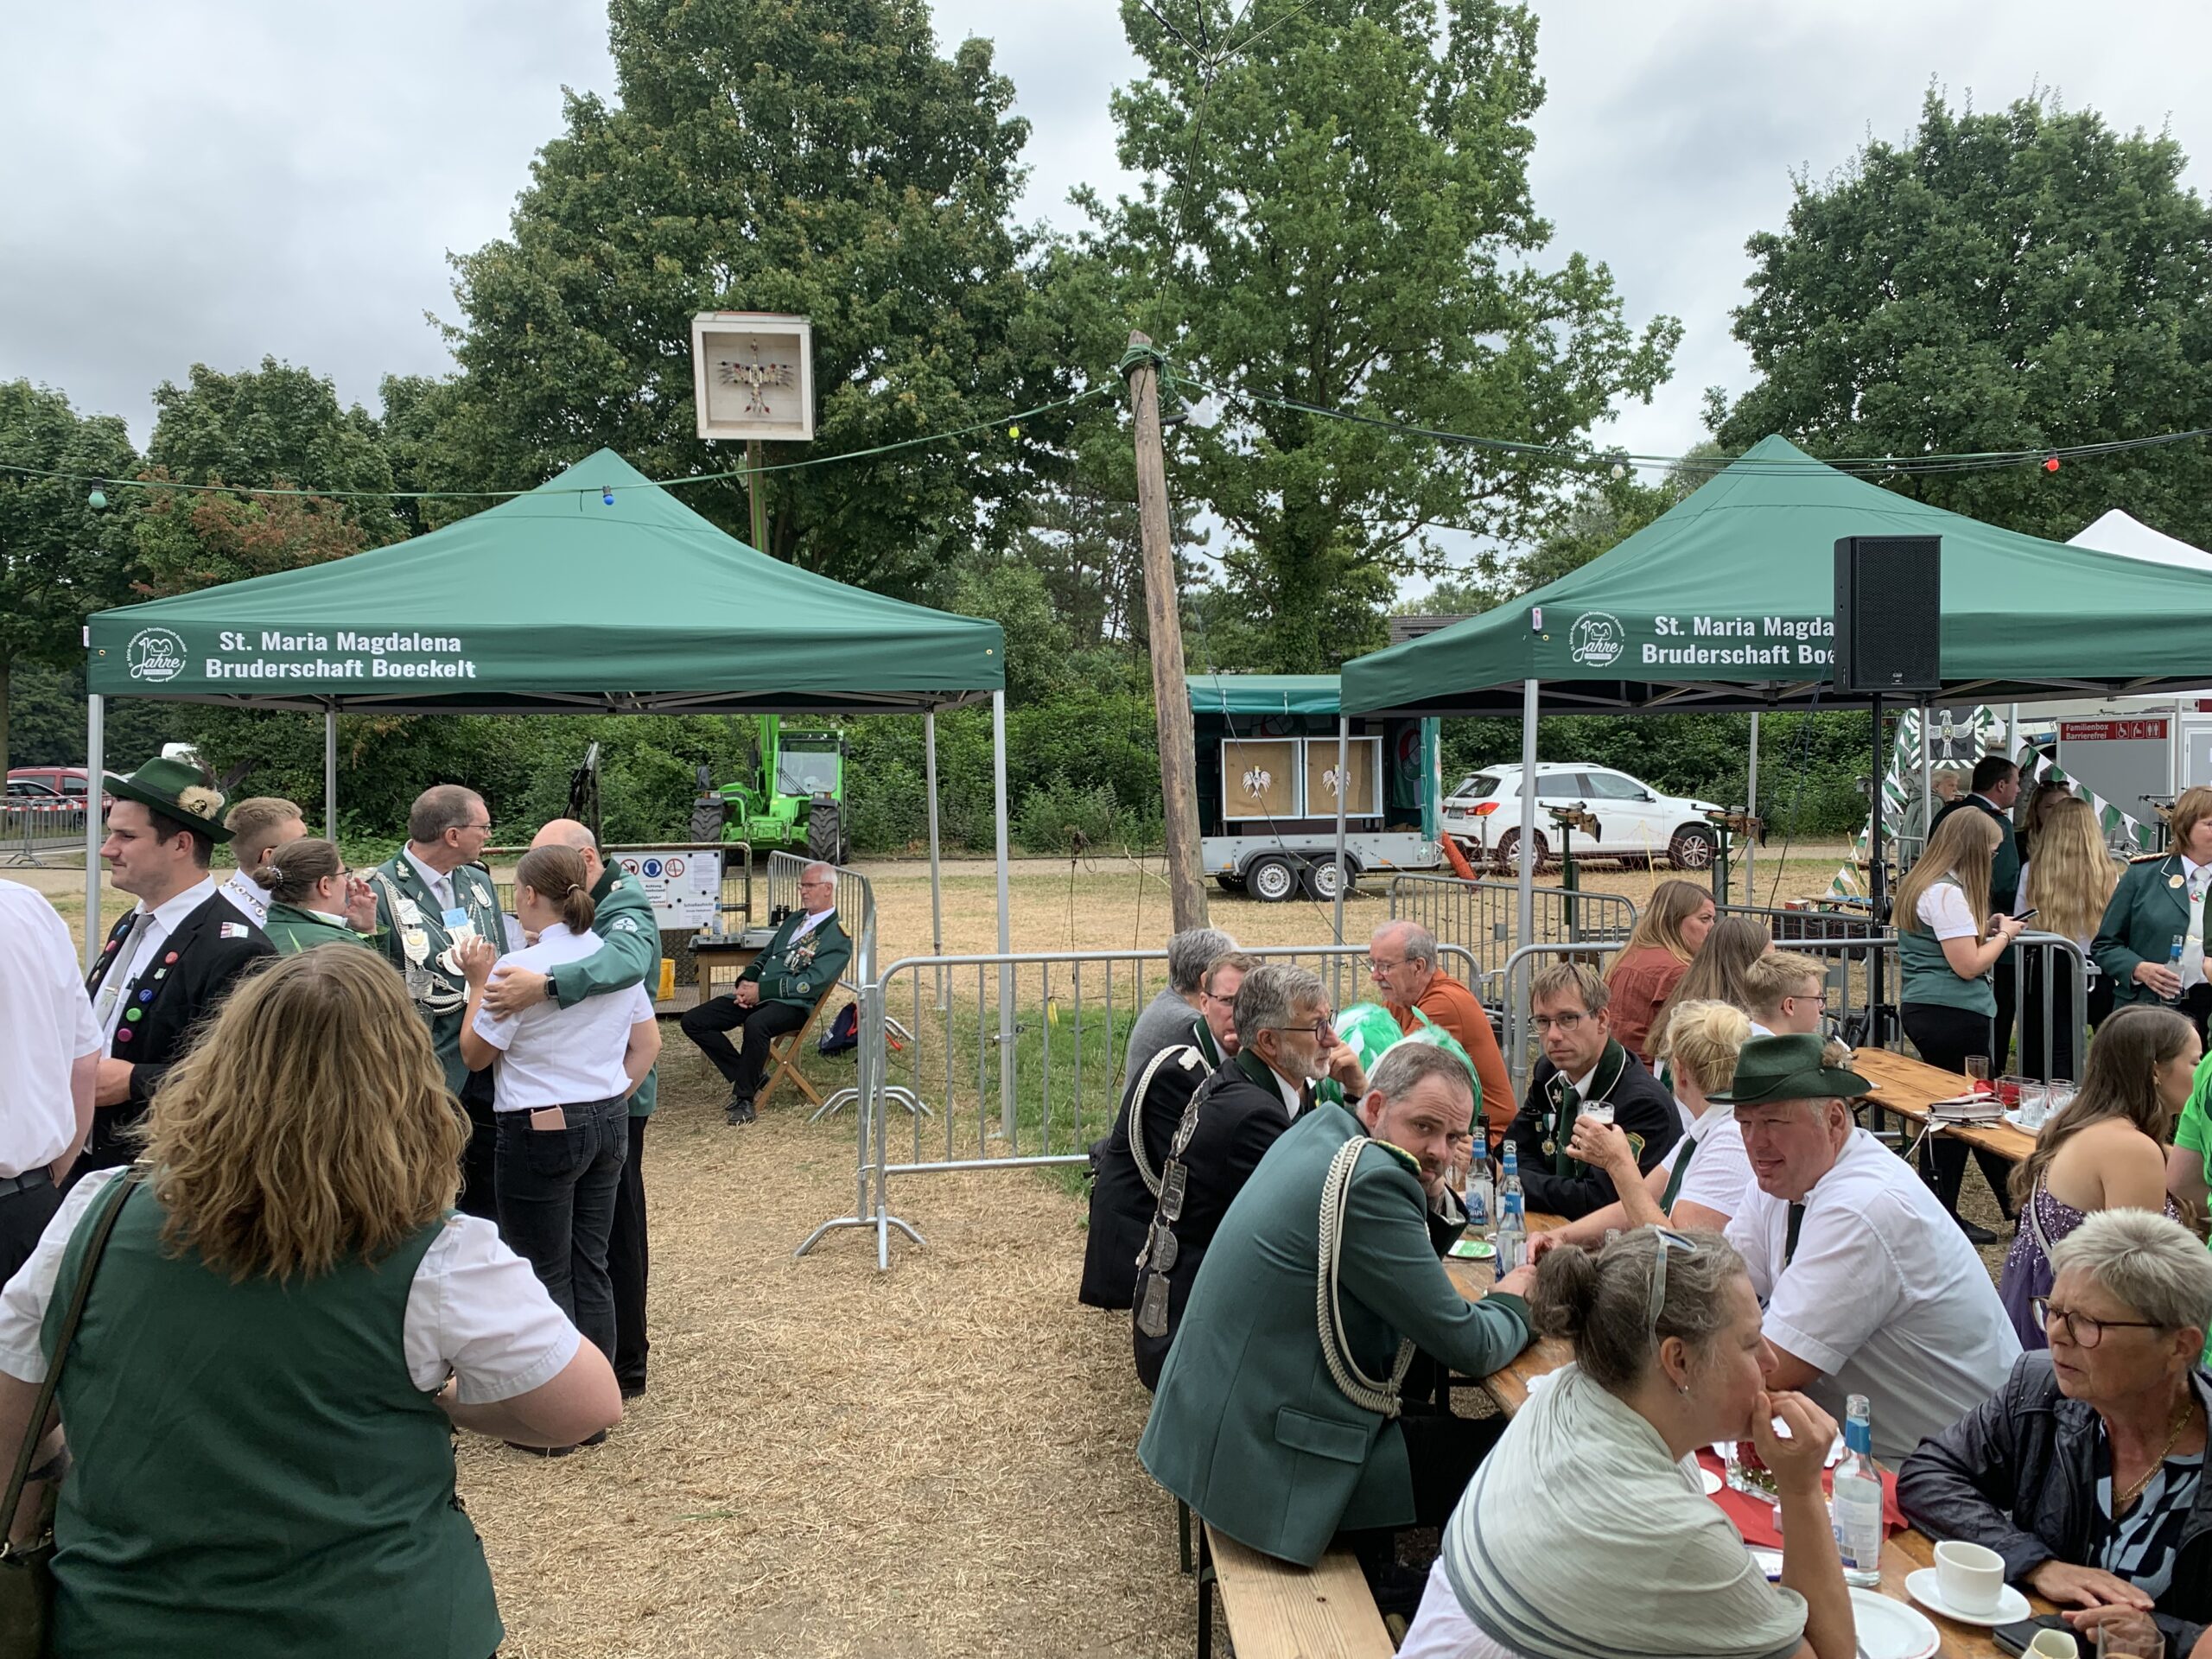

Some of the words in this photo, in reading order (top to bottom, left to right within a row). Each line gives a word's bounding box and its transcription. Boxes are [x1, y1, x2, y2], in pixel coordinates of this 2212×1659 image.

[1655, 615, 1685, 636] St.
[1693, 616, 1755, 637] Maria
[1764, 616, 1834, 640] Magda
[219, 631, 252, 652] St.
[261, 631, 328, 652] Maria
[337, 632, 461, 655] Magdalena
[1642, 643, 1790, 664] Bruderschaft
[1797, 645, 1834, 664] Boe
[206, 658, 365, 678] Bruderschaft
[372, 658, 476, 679] Boeckelt
[2066, 723, 2109, 732] Familienbox
